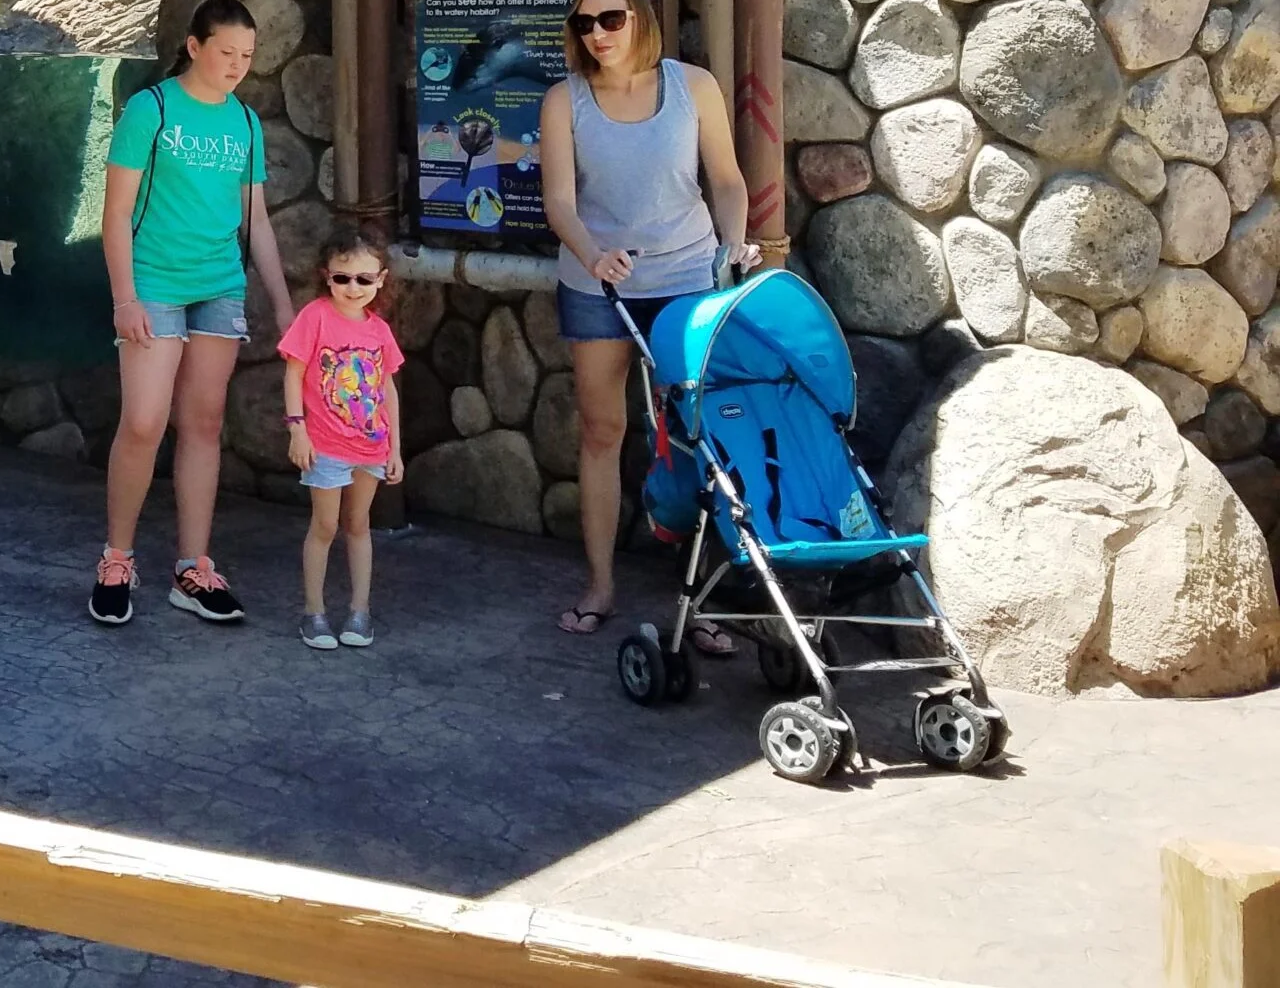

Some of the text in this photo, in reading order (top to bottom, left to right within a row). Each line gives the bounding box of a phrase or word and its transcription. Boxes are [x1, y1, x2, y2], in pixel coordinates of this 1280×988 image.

[444, 9, 468, 17] watery
[470, 8, 499, 16] habitat?
[523, 50, 544, 58] That
[453, 108, 473, 123] Look
[161, 125, 220, 153] SIOUX
[184, 151, 217, 161] SOUTH
[519, 221, 534, 230] long
